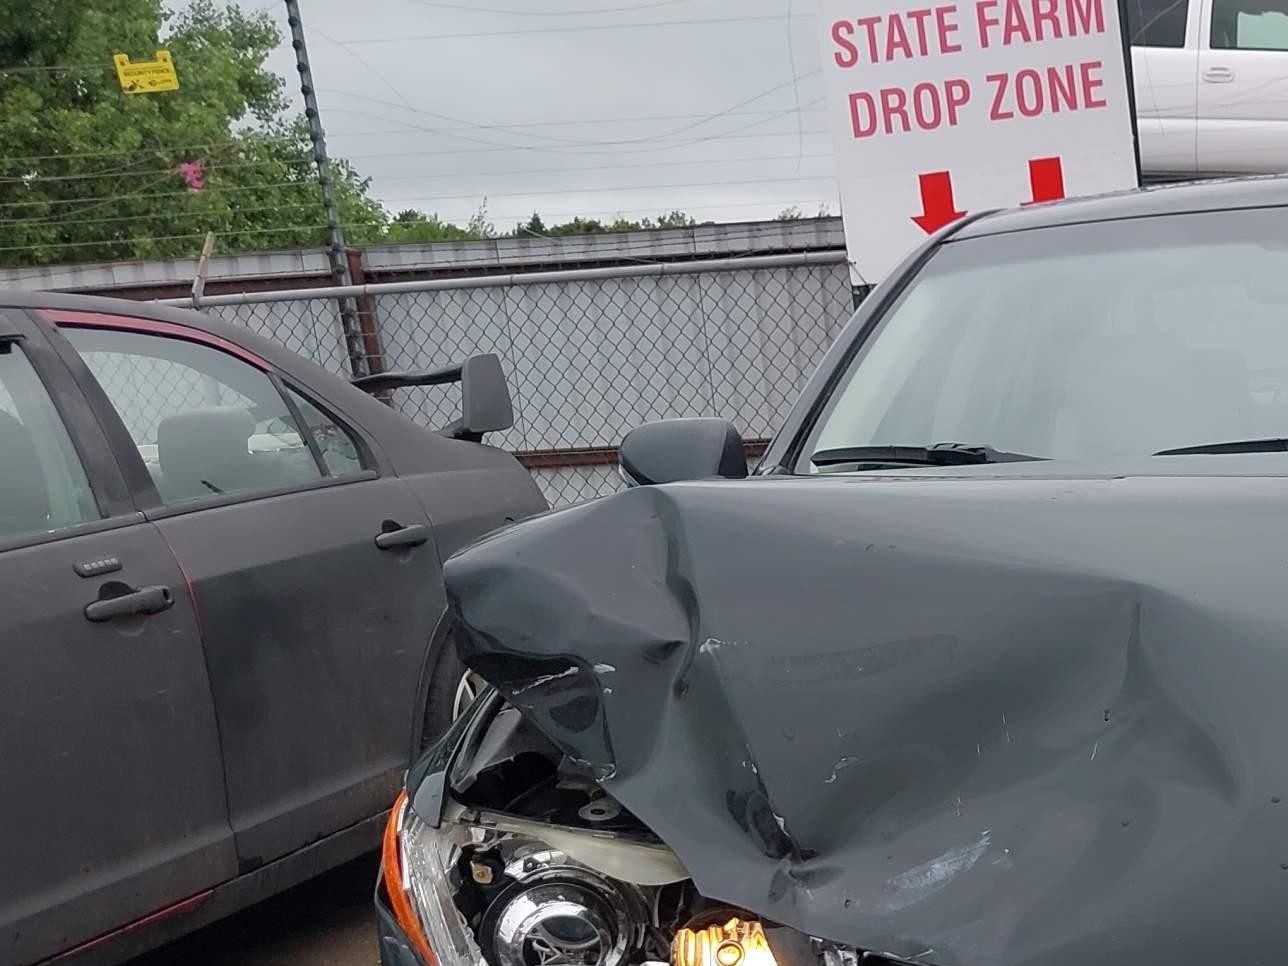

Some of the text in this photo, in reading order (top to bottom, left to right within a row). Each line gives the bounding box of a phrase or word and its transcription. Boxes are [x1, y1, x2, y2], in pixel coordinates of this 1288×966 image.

[831, 0, 1105, 68] STATE FARM
[849, 61, 1107, 138] DROP ZONE
